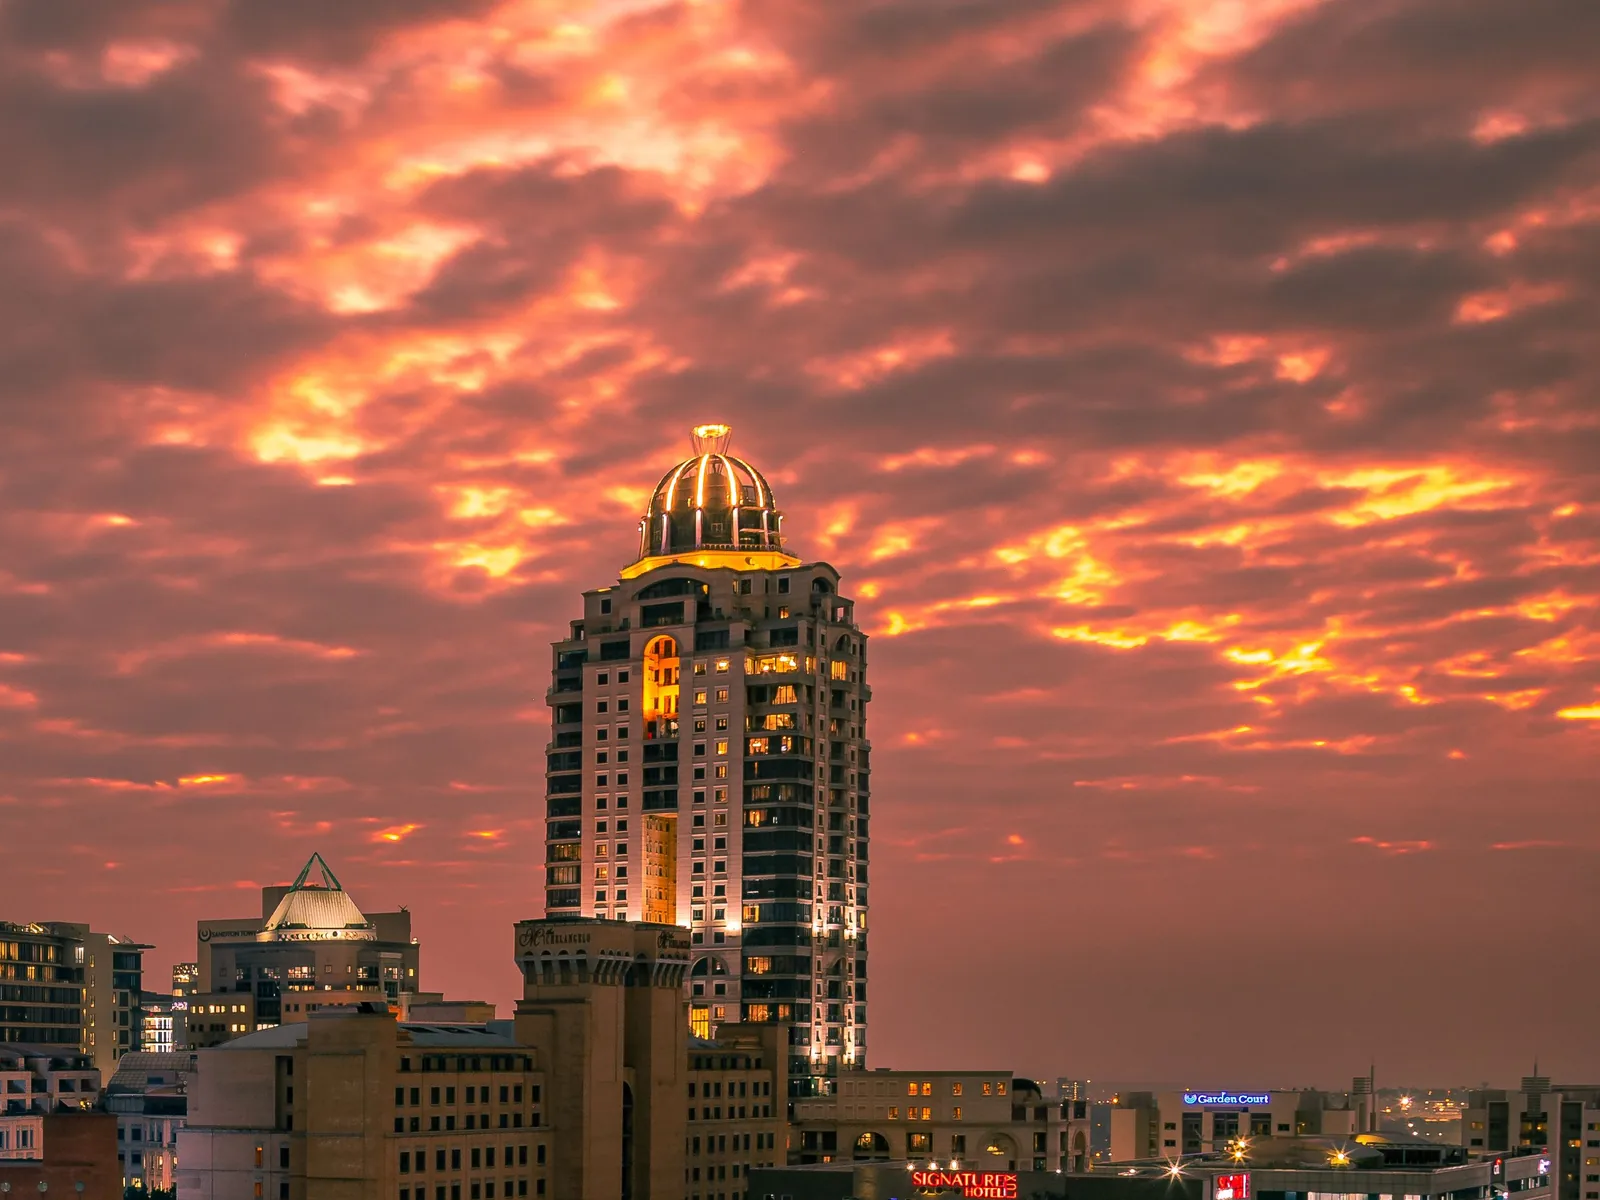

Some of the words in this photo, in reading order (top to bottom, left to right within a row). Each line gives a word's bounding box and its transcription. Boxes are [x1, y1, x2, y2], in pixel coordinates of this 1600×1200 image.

[1197, 1092, 1238, 1104] Garden
[1238, 1094, 1269, 1104] Court
[912, 1171, 1005, 1188] SIGNATURE
[965, 1187, 1003, 1198] HOTEL
